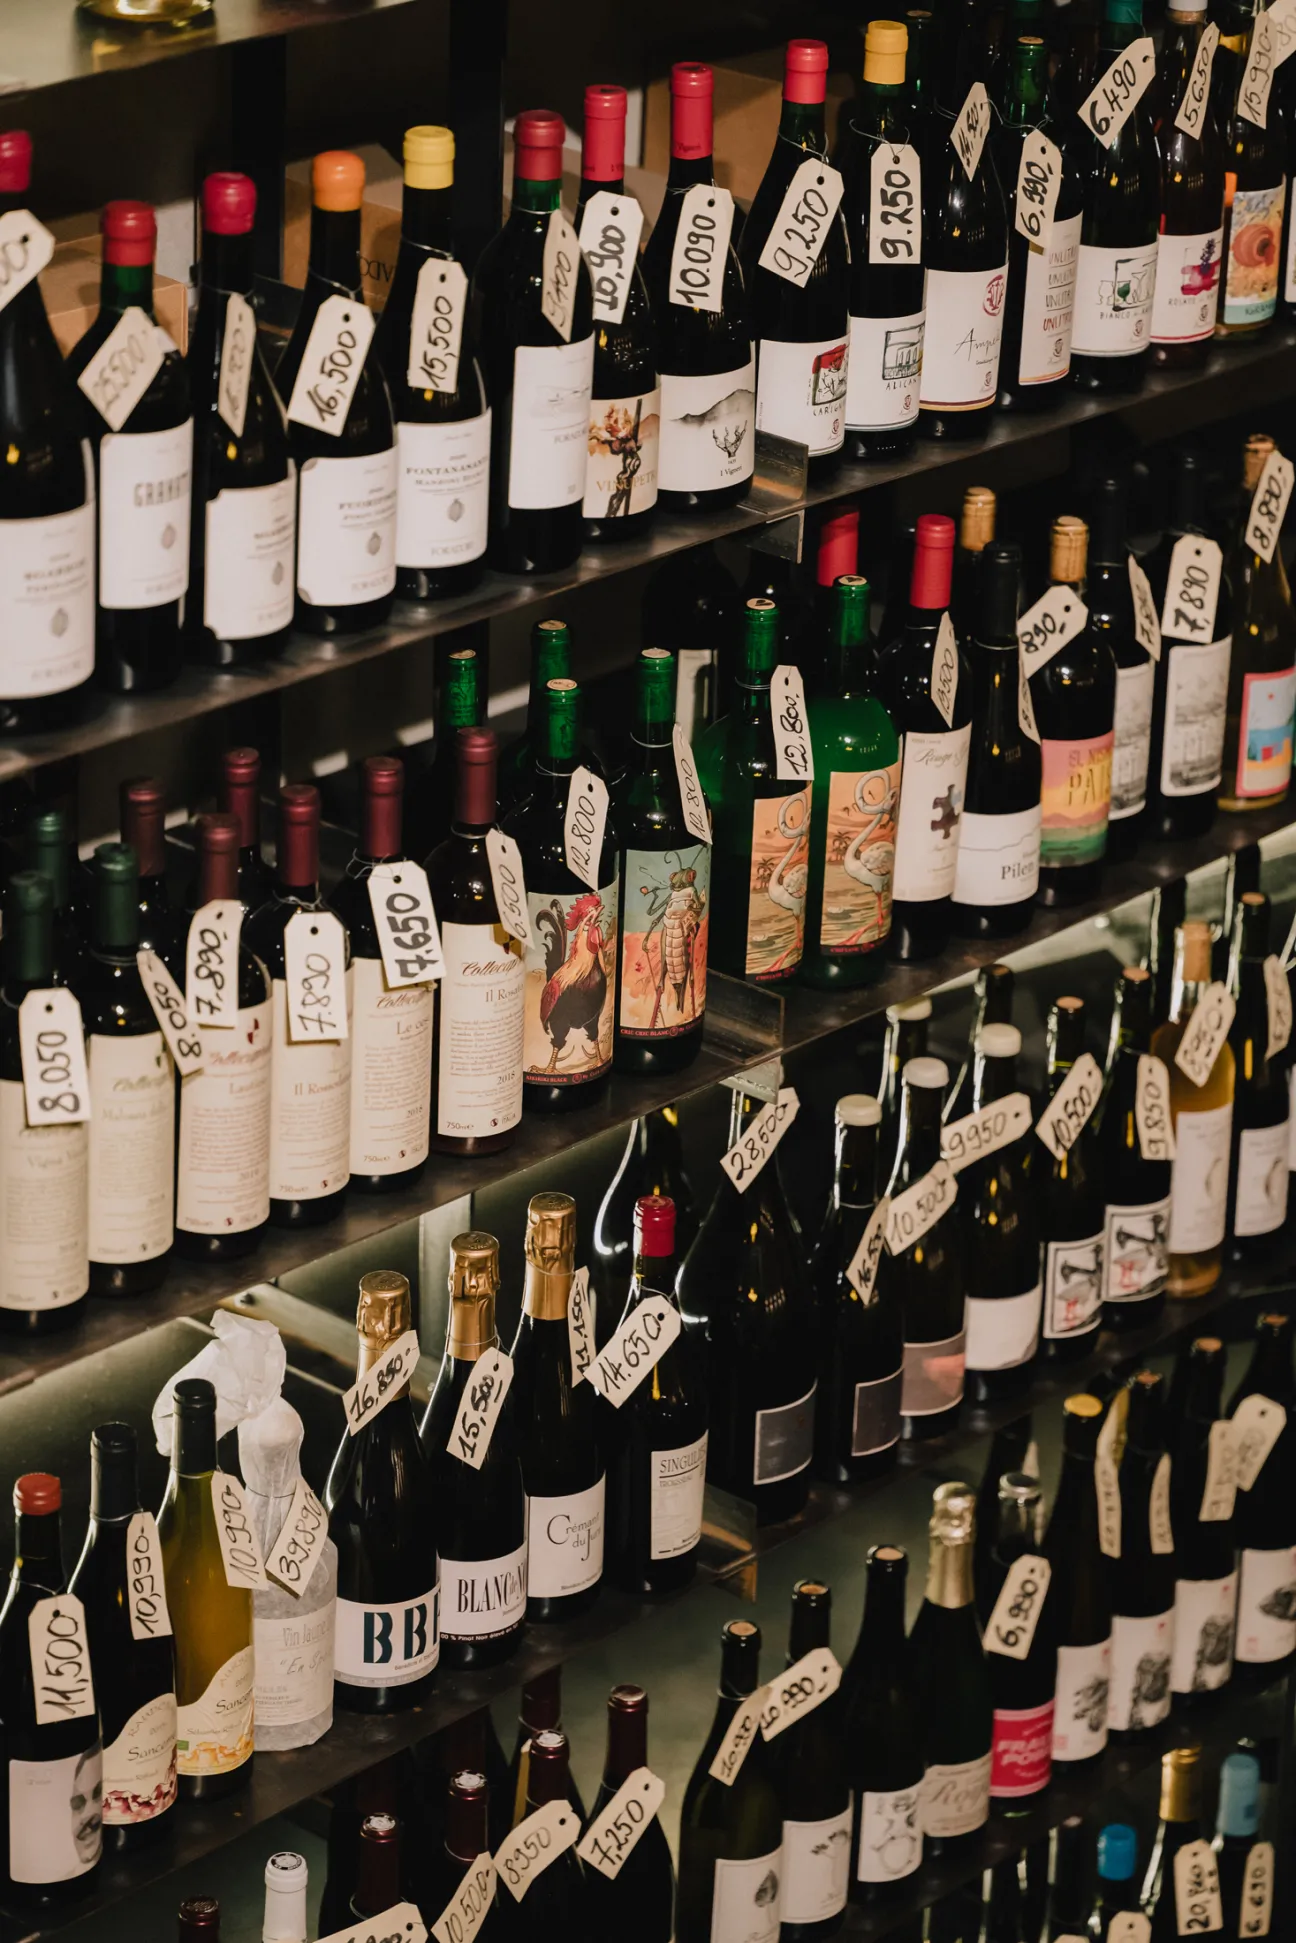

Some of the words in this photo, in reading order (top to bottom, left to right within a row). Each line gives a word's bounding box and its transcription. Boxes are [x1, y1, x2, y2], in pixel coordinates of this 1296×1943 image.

[1090, 60, 1137, 135] 6.490
[773, 188, 829, 278] 9,250
[879, 169, 914, 259] 9.250
[676, 213, 717, 304] 10.090
[307, 331, 357, 422] 16,500
[419, 296, 457, 388] 15,500
[570, 795, 596, 883] 12.800
[501, 863, 528, 939] 6.500
[36, 1031, 80, 1113] 8.050
[730, 1104, 786, 1181] 28,500
[598, 1313, 661, 1394] 14.650
[572, 1533, 586, 1548] du
[132, 1534, 157, 1635] 10,990
[457, 1571, 512, 1613] BLANC
[42, 1613, 89, 1715] 11,500
[590, 1798, 645, 1867] 7,250
